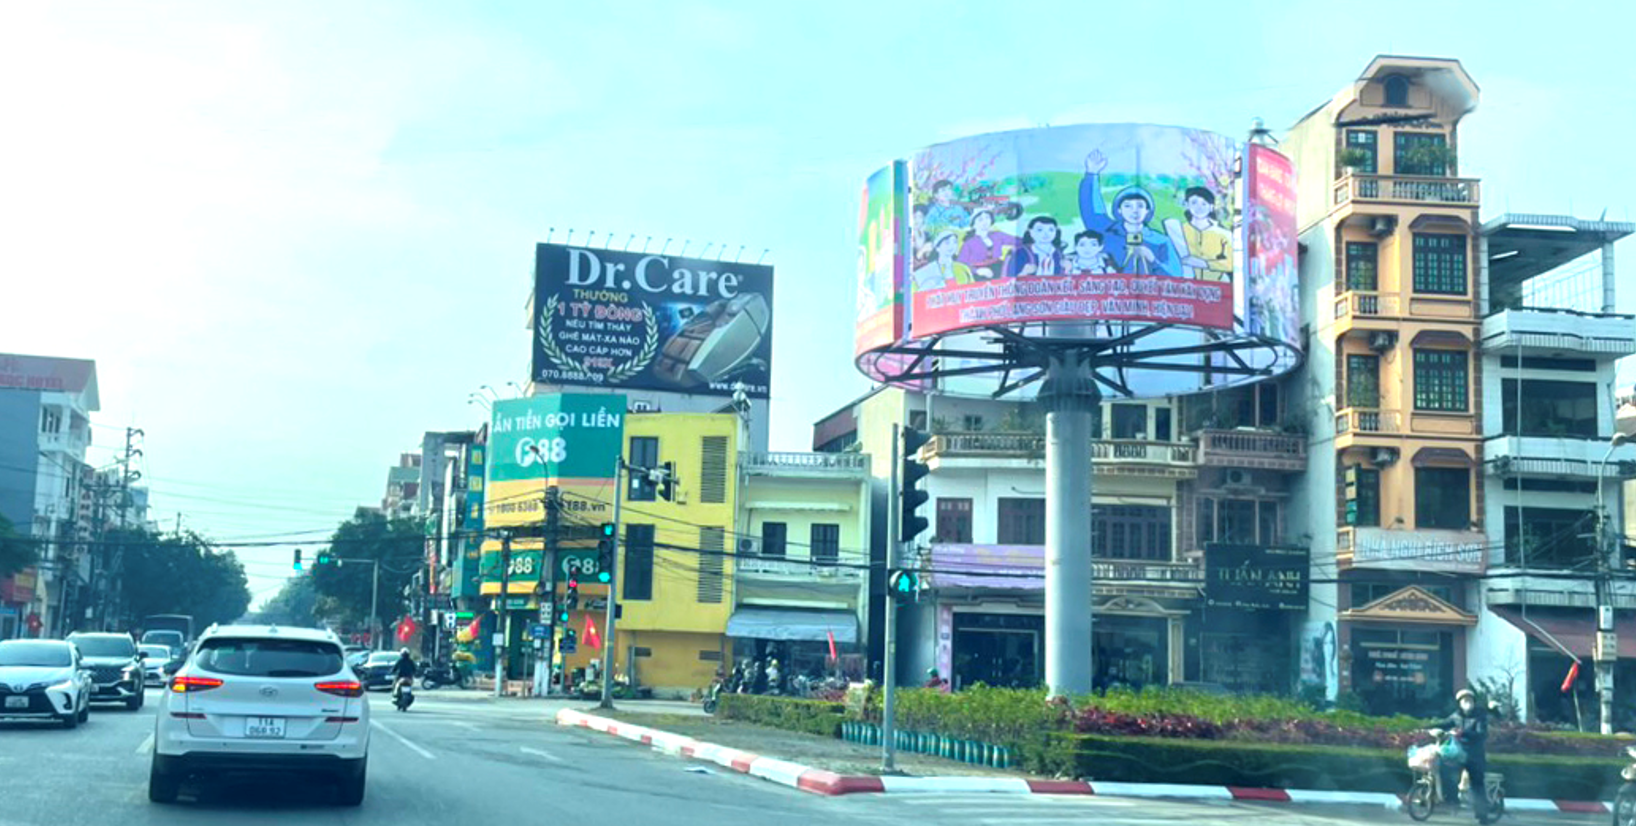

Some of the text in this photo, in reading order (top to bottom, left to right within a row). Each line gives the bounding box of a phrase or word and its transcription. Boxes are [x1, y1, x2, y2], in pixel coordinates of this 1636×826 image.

[565, 247, 739, 299] Dr.Care
[1028, 277, 1053, 297] ĐOÀN
[1079, 277, 1105, 295] SÁNG
[558, 300, 566, 317] 1
[565, 343, 587, 354] CAO
[545, 412, 576, 431] GỌI
[581, 406, 620, 428] LIỀN
[515, 437, 567, 468] F88
[508, 557, 533, 575] 88
